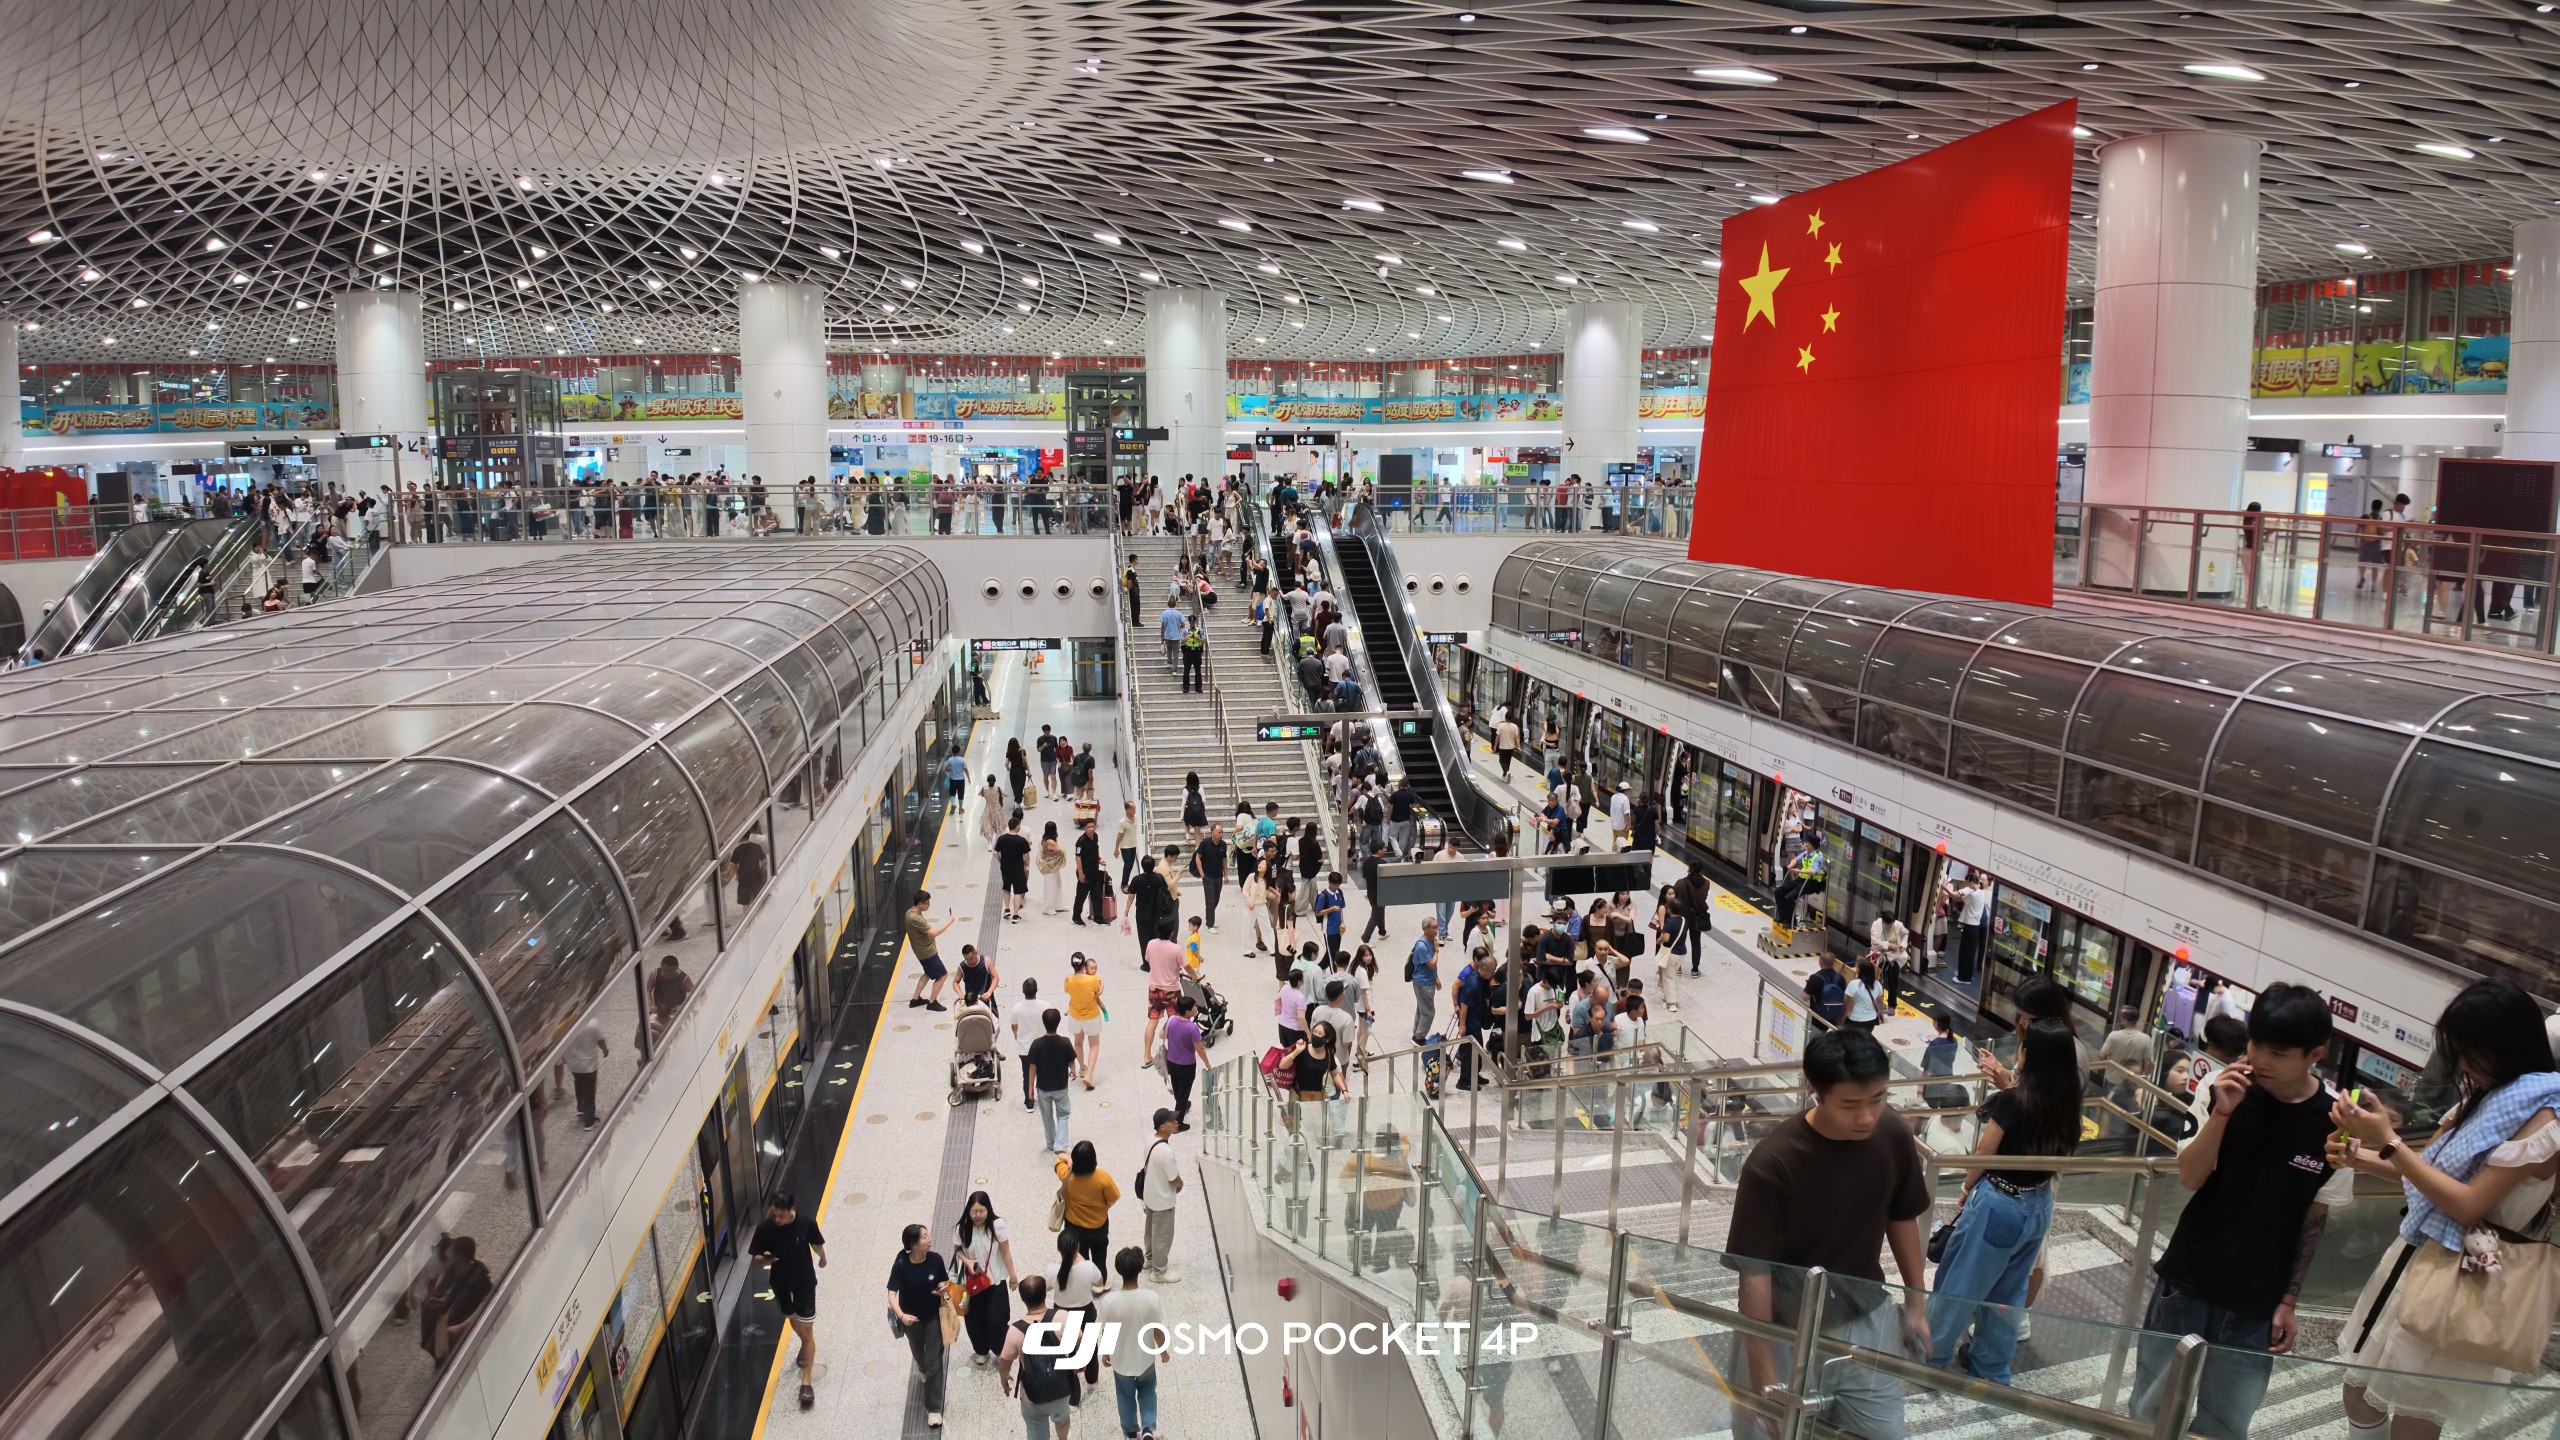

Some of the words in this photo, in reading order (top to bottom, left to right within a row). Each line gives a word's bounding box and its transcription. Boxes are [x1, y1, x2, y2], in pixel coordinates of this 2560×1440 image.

[955, 399, 1056, 418] 开心游玩去哪好
[1274, 402, 1366, 422] 开心游玩去哪好
[872, 434, 888, 443] 1-6
[929, 434, 954, 443] 19-16
[1507, 465, 1527, 473] 寄存处
